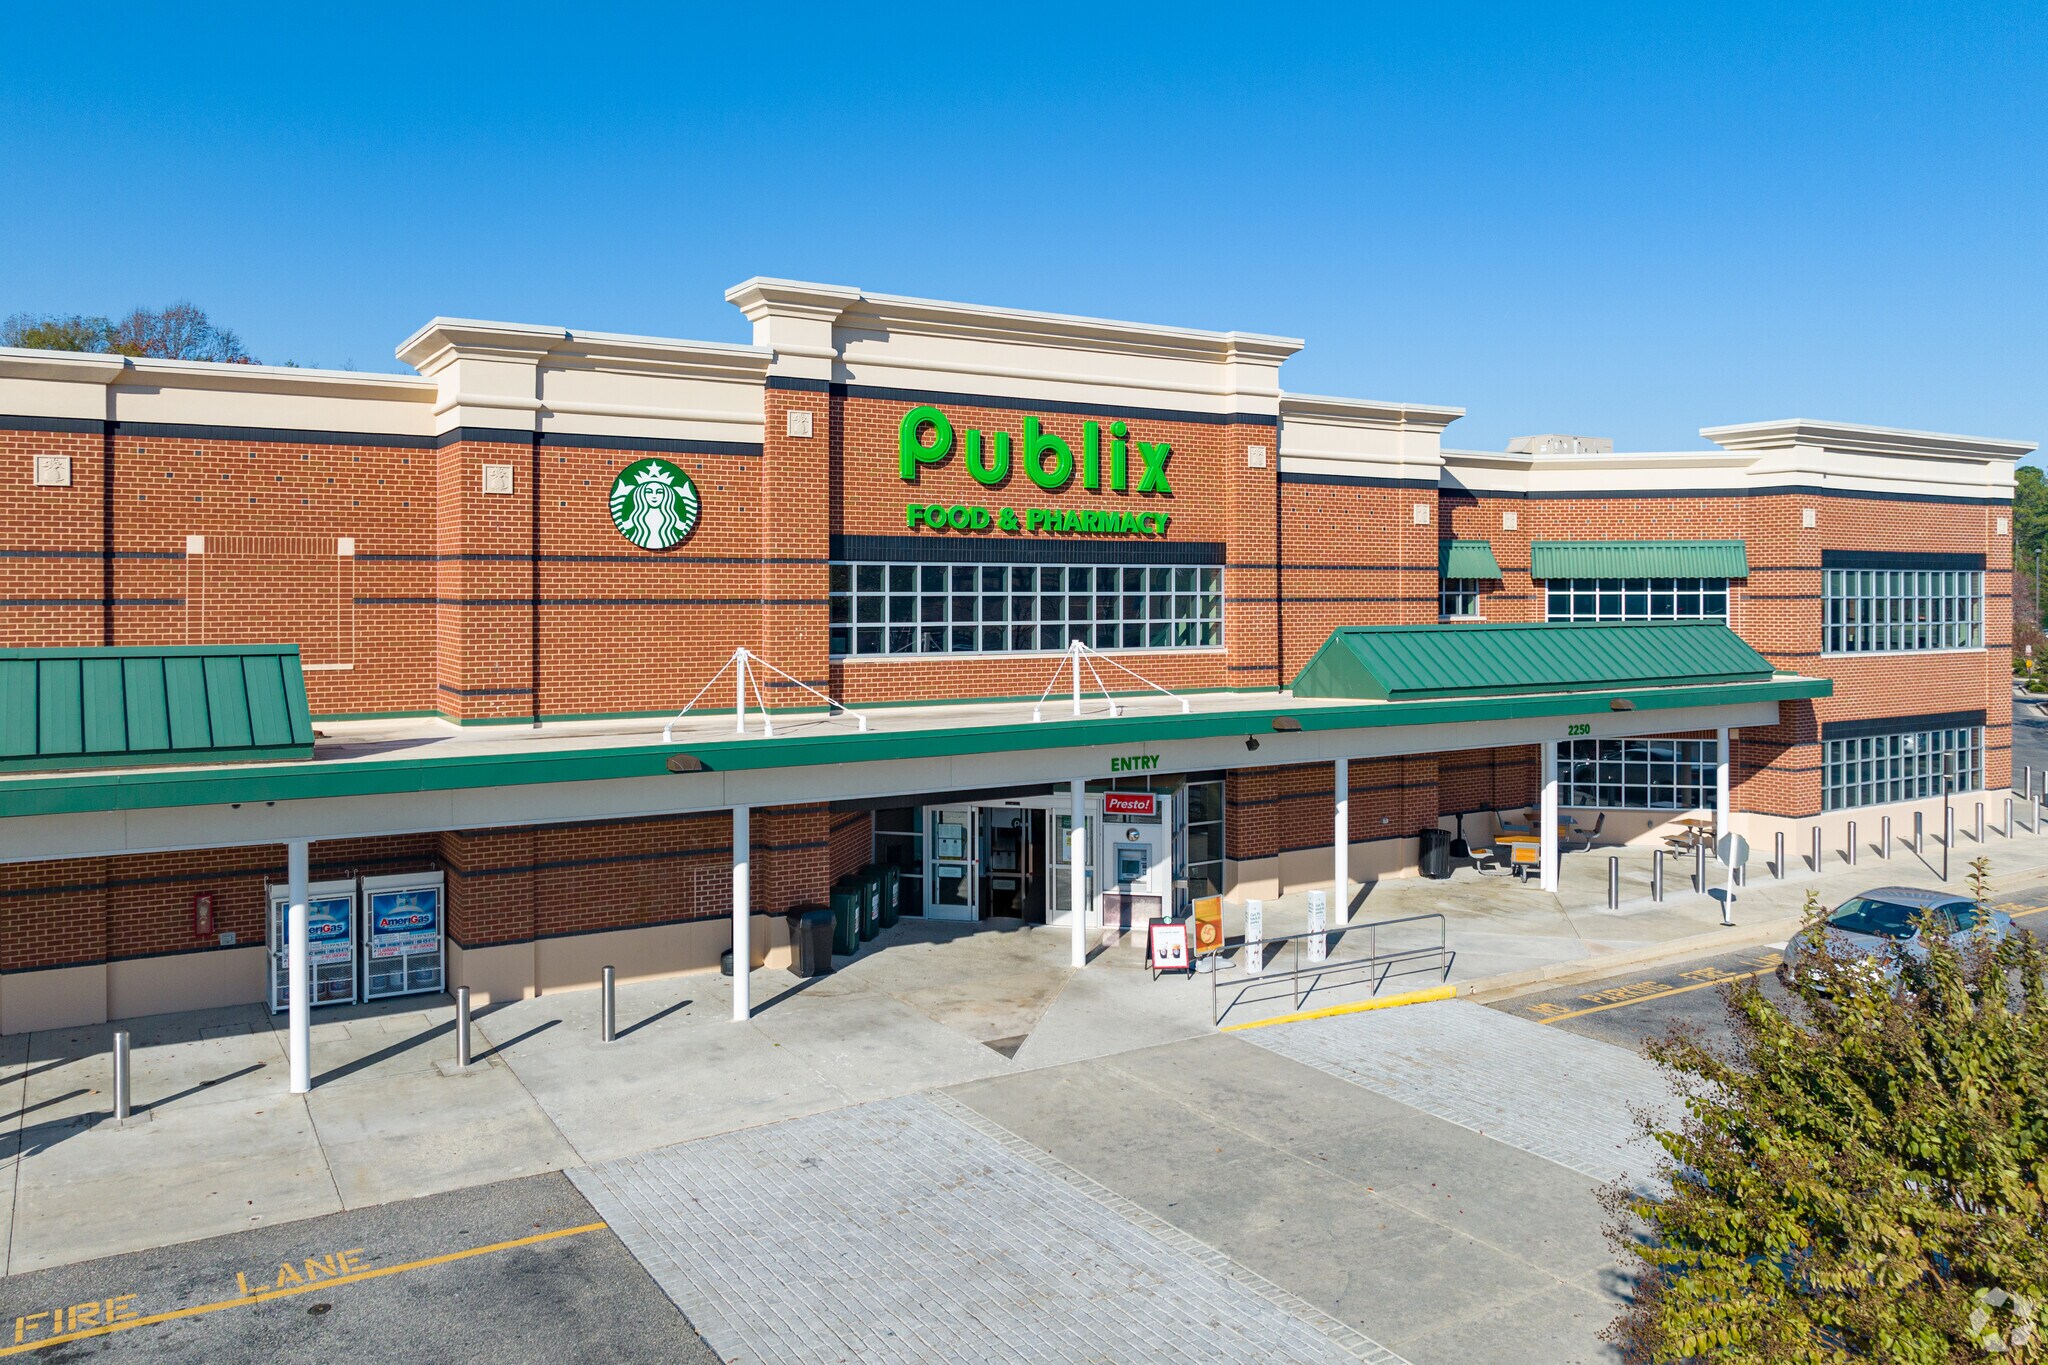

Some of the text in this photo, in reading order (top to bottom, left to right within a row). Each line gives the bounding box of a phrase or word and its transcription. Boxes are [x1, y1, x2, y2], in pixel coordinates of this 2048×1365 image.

[899, 405, 1172, 493] Publix
[906, 503, 1170, 534] FOOD & PHARMACY
[1568, 723, 1591, 736] 2250
[1111, 754, 1160, 772] ENTRY
[1109, 798, 1150, 810] Presto!
[308, 923, 343, 934] eriGas
[380, 914, 430, 927] AmeriGas
[1578, 981, 1674, 1005] PARKING
[1679, 966, 1737, 982] FIRE
[14, 1247, 371, 1343] FIRE LANE
